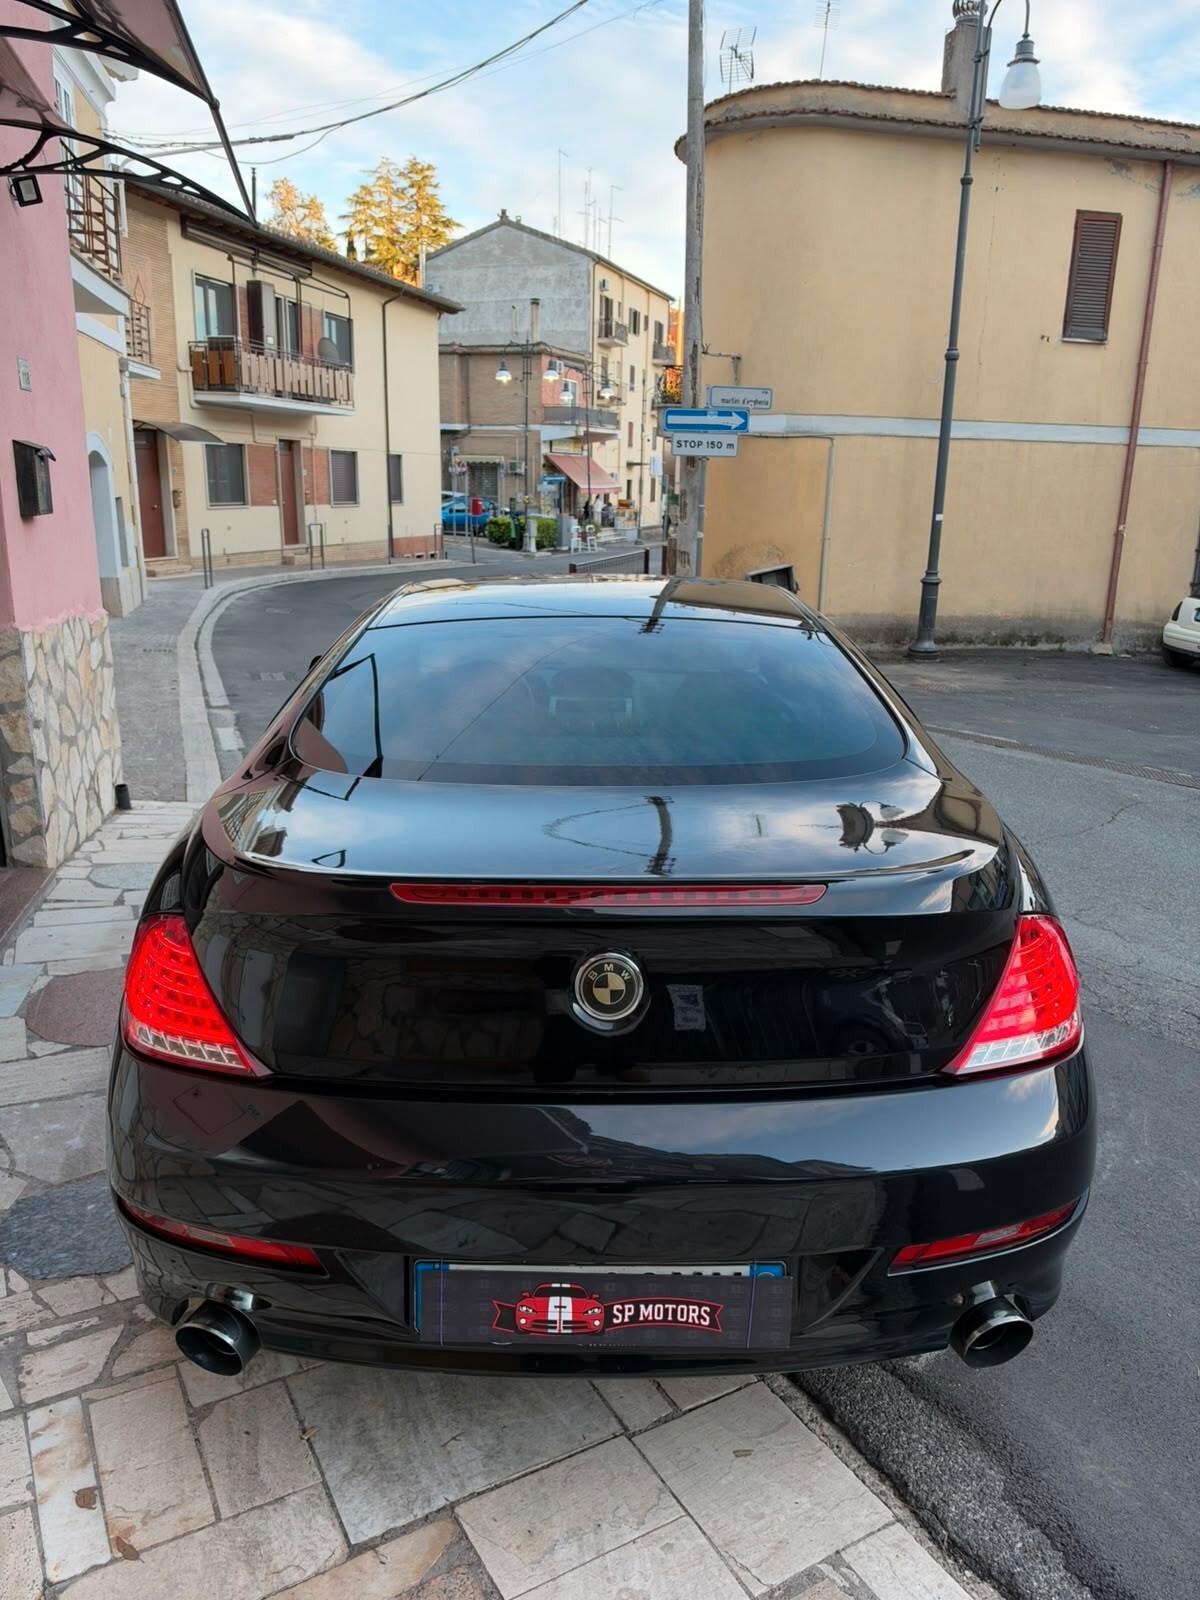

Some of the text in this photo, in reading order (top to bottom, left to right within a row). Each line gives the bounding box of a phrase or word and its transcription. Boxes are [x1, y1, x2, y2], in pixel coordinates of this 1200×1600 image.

[676, 440, 703, 449] STOP
[706, 440, 723, 449] 150
[587, 963, 632, 981] BMW
[612, 1304, 711, 1326] SP MOTORS
